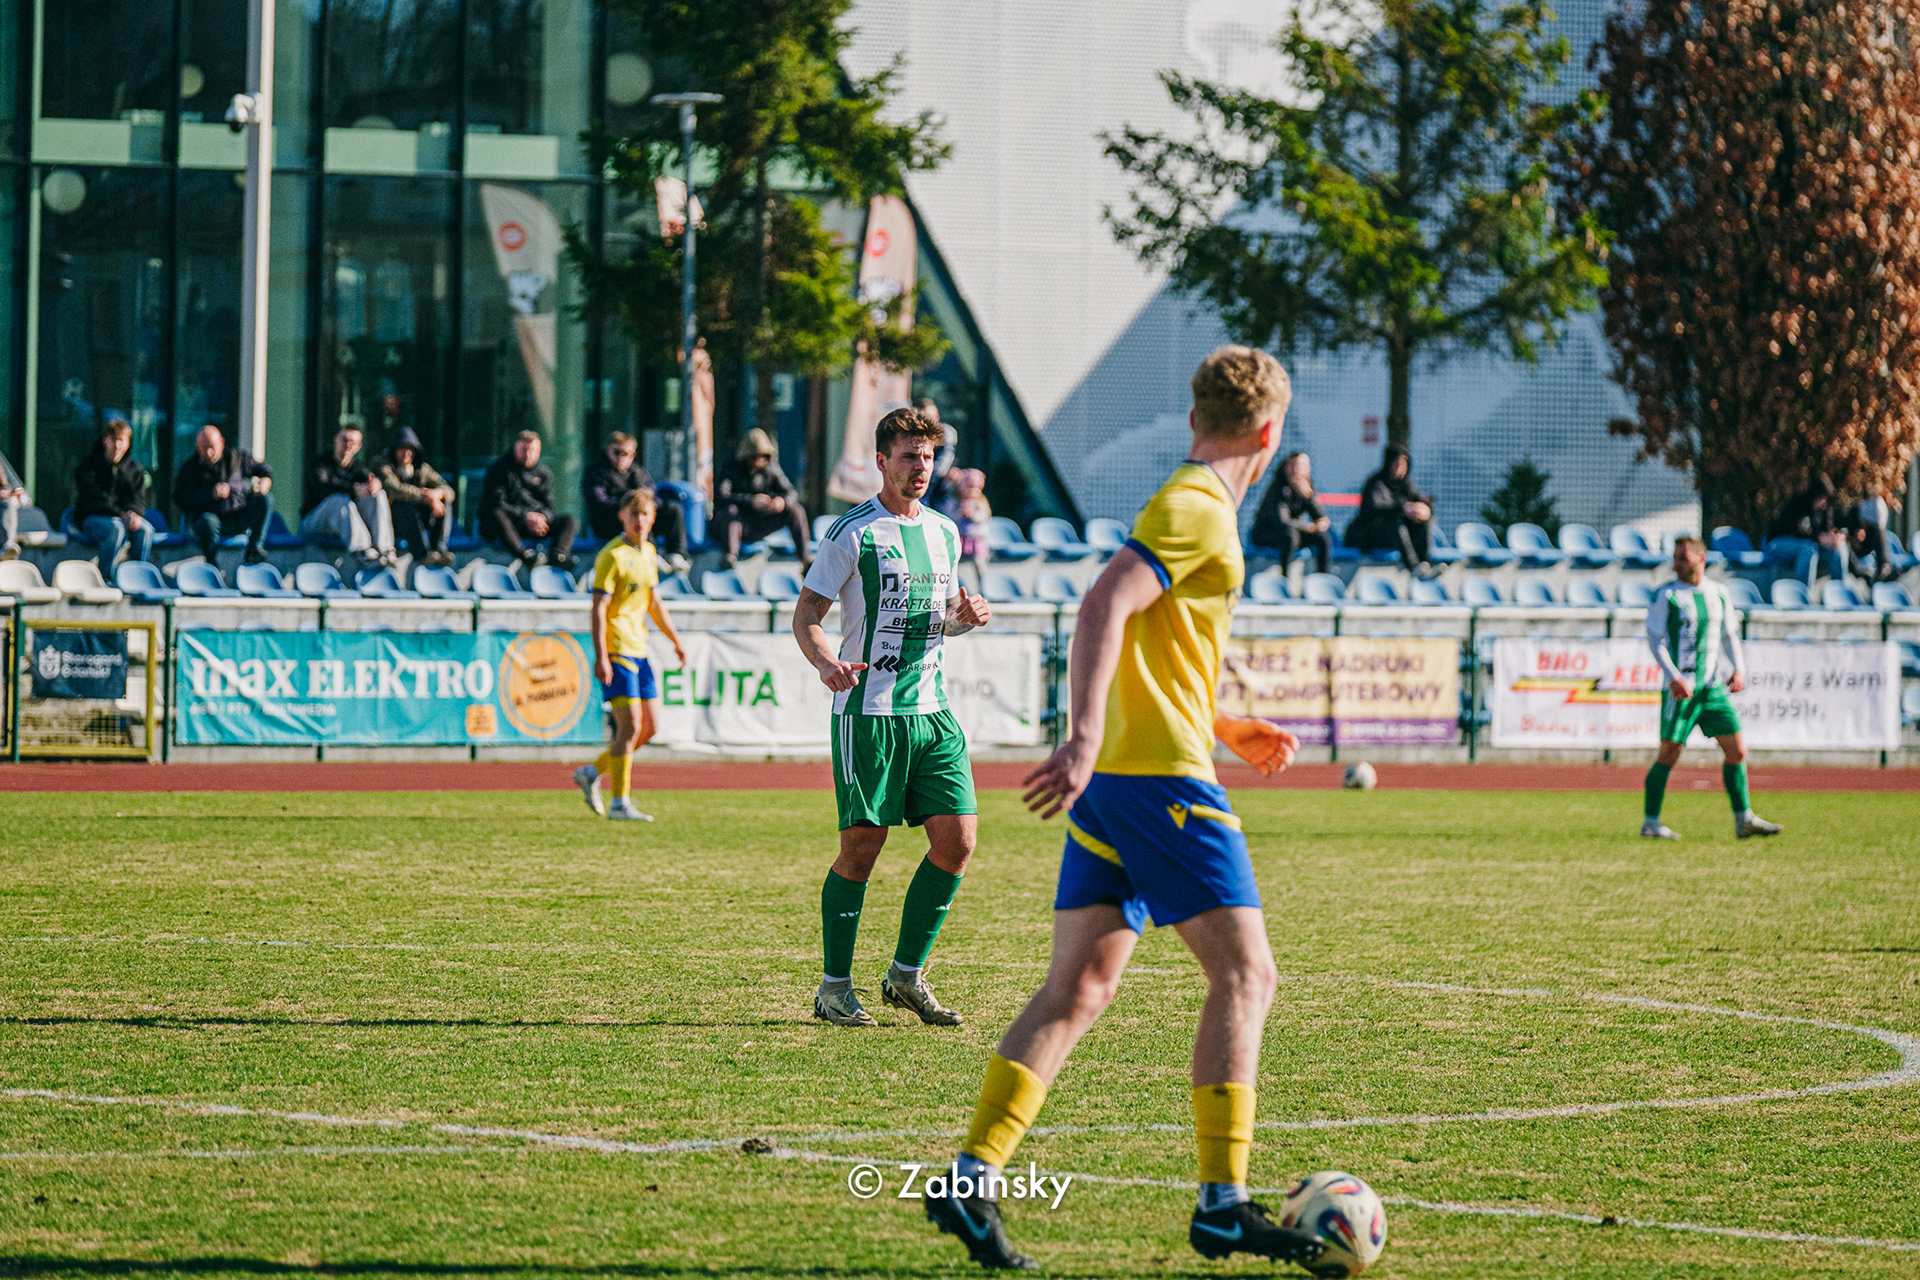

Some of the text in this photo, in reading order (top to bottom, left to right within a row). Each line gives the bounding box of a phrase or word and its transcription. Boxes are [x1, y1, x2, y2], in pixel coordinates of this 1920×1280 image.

[190, 657, 299, 698] max
[306, 659, 494, 699] ELEKTRO
[662, 670, 780, 707] ELITA
